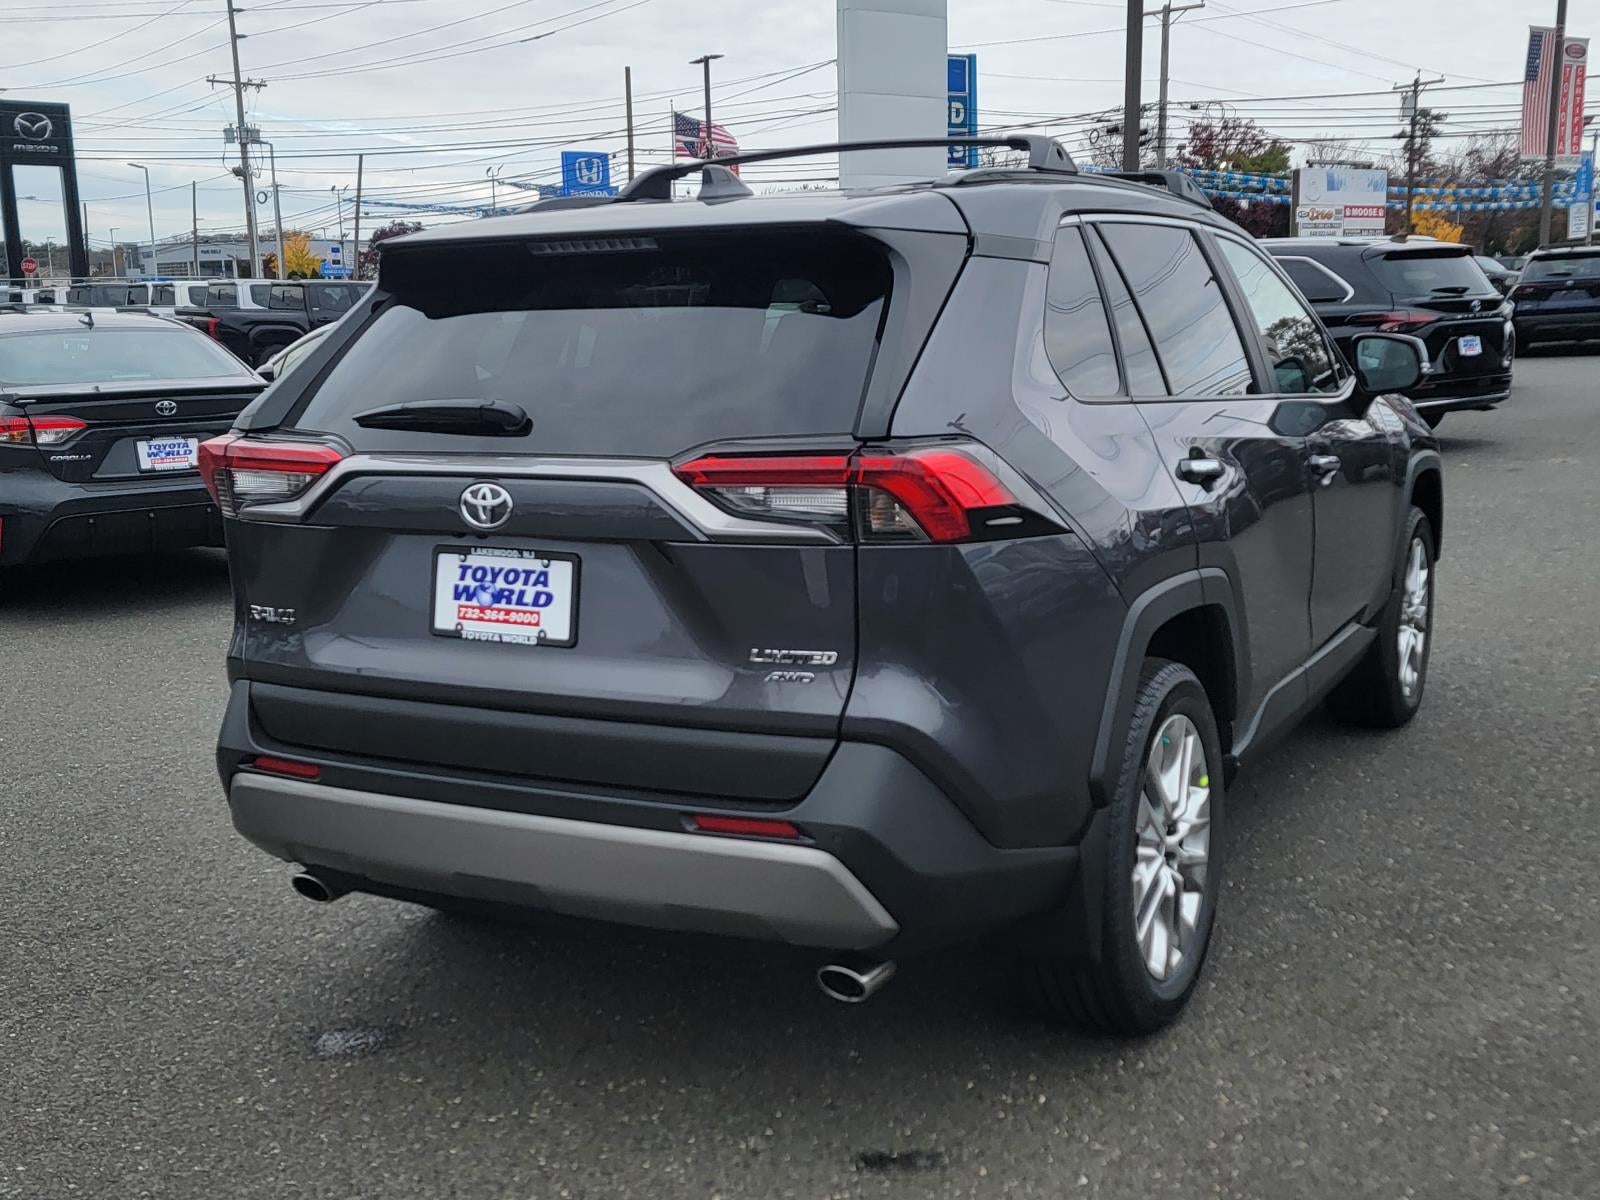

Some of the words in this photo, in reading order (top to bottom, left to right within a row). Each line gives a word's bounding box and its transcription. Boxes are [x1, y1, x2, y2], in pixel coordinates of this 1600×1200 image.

[1558, 66, 1571, 153] TOYOTA
[1572, 67, 1585, 153] CERTIFIED
[1351, 207, 1378, 217] MOOSE
[22, 262, 36, 270] STOP
[146, 442, 189, 451] TOYOTA
[146, 449, 192, 458] WORLD
[522, 550, 535, 559] NJ
[457, 564, 549, 588] TOYOTA
[452, 583, 554, 608] WORLD
[461, 630, 501, 642] TOYOTA
[502, 634, 538, 645] WORLD
[764, 671, 815, 683] AWD
